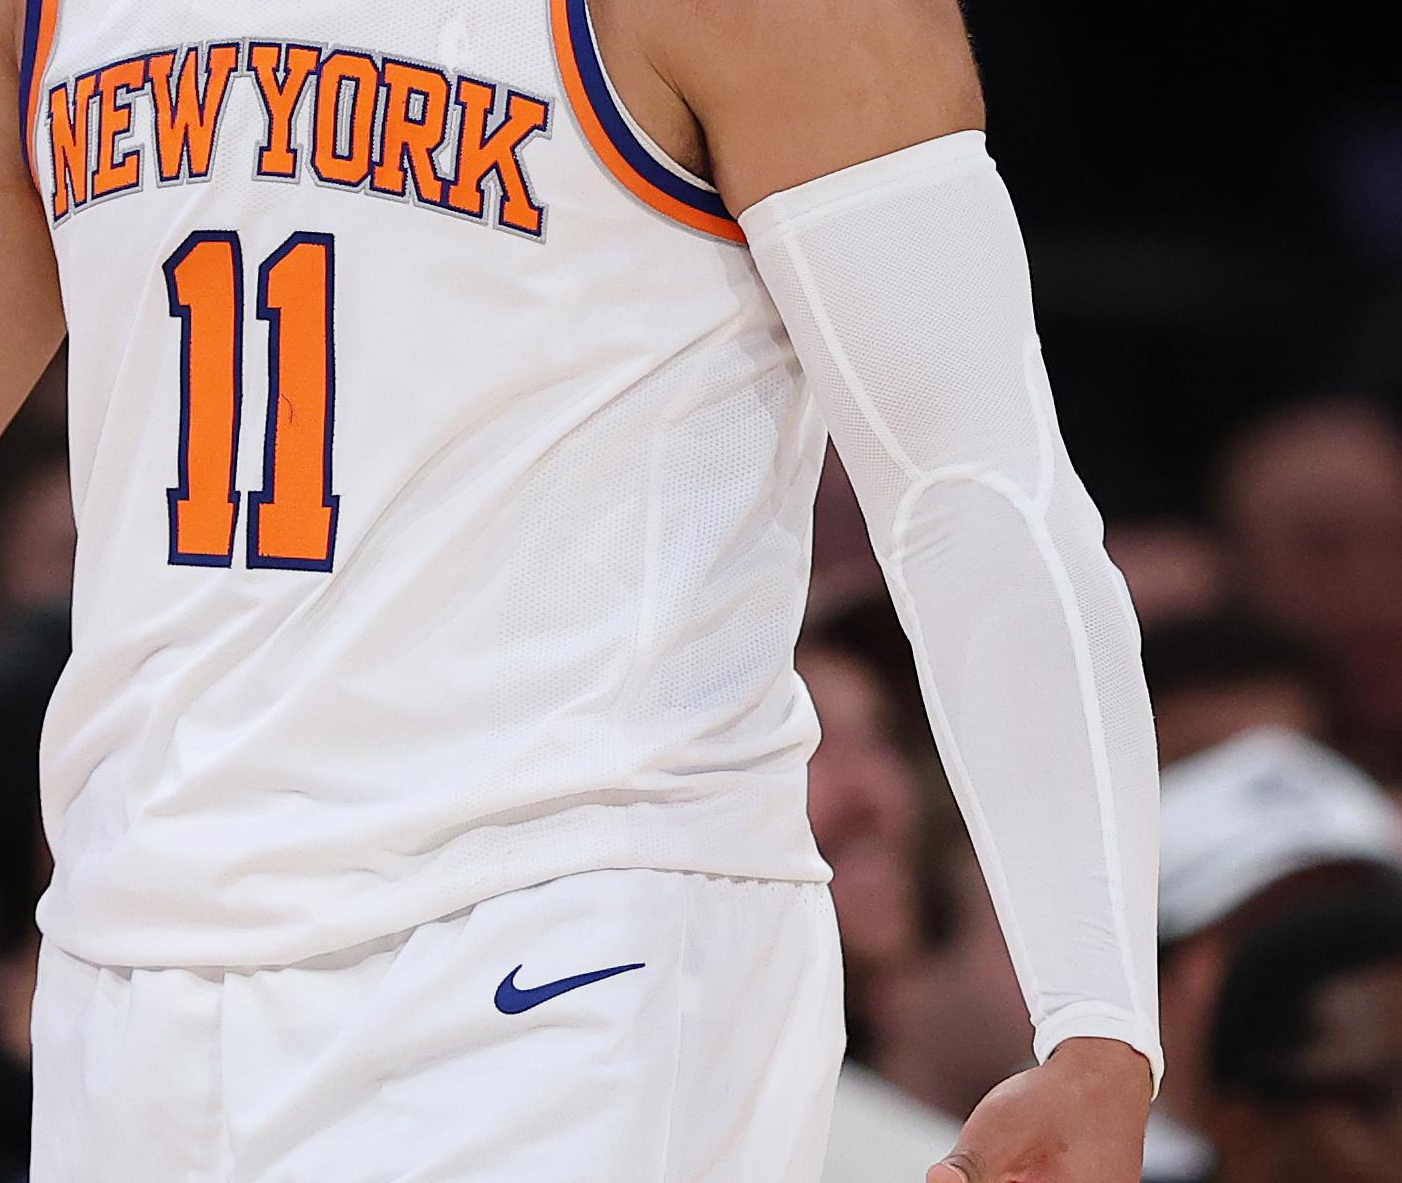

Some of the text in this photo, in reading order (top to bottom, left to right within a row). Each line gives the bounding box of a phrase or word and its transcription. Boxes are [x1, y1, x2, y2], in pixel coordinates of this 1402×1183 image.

[44, 39, 552, 239] NEW YORK
[161, 228, 341, 574] 11
